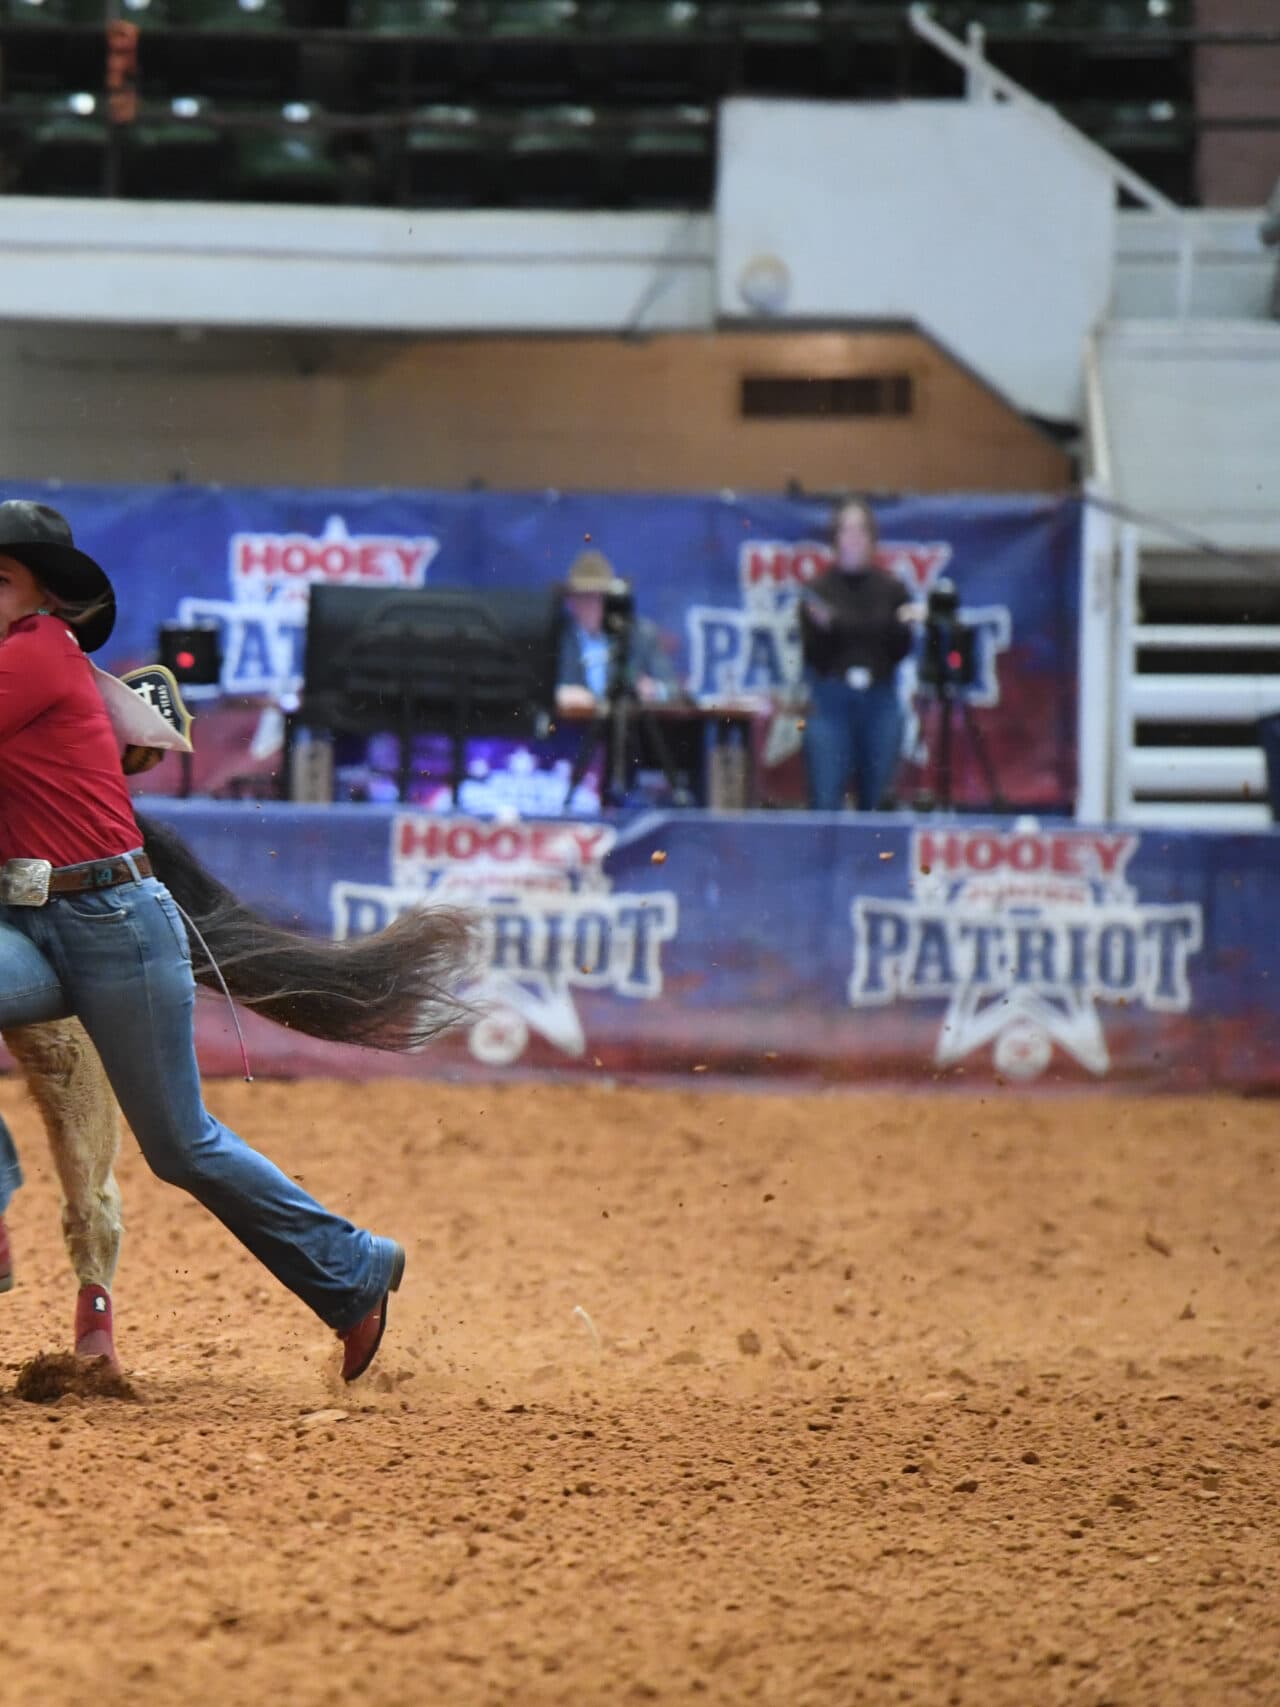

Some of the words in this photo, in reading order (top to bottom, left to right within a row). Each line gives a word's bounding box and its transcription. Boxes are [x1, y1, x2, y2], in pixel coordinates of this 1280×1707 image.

[241, 544, 423, 578] HOOEY
[401, 823, 603, 864] HOOEY
[921, 834, 1129, 873] HOOEY
[344, 896, 667, 986] PRIOT
[863, 909, 1192, 999] PATRIOT
